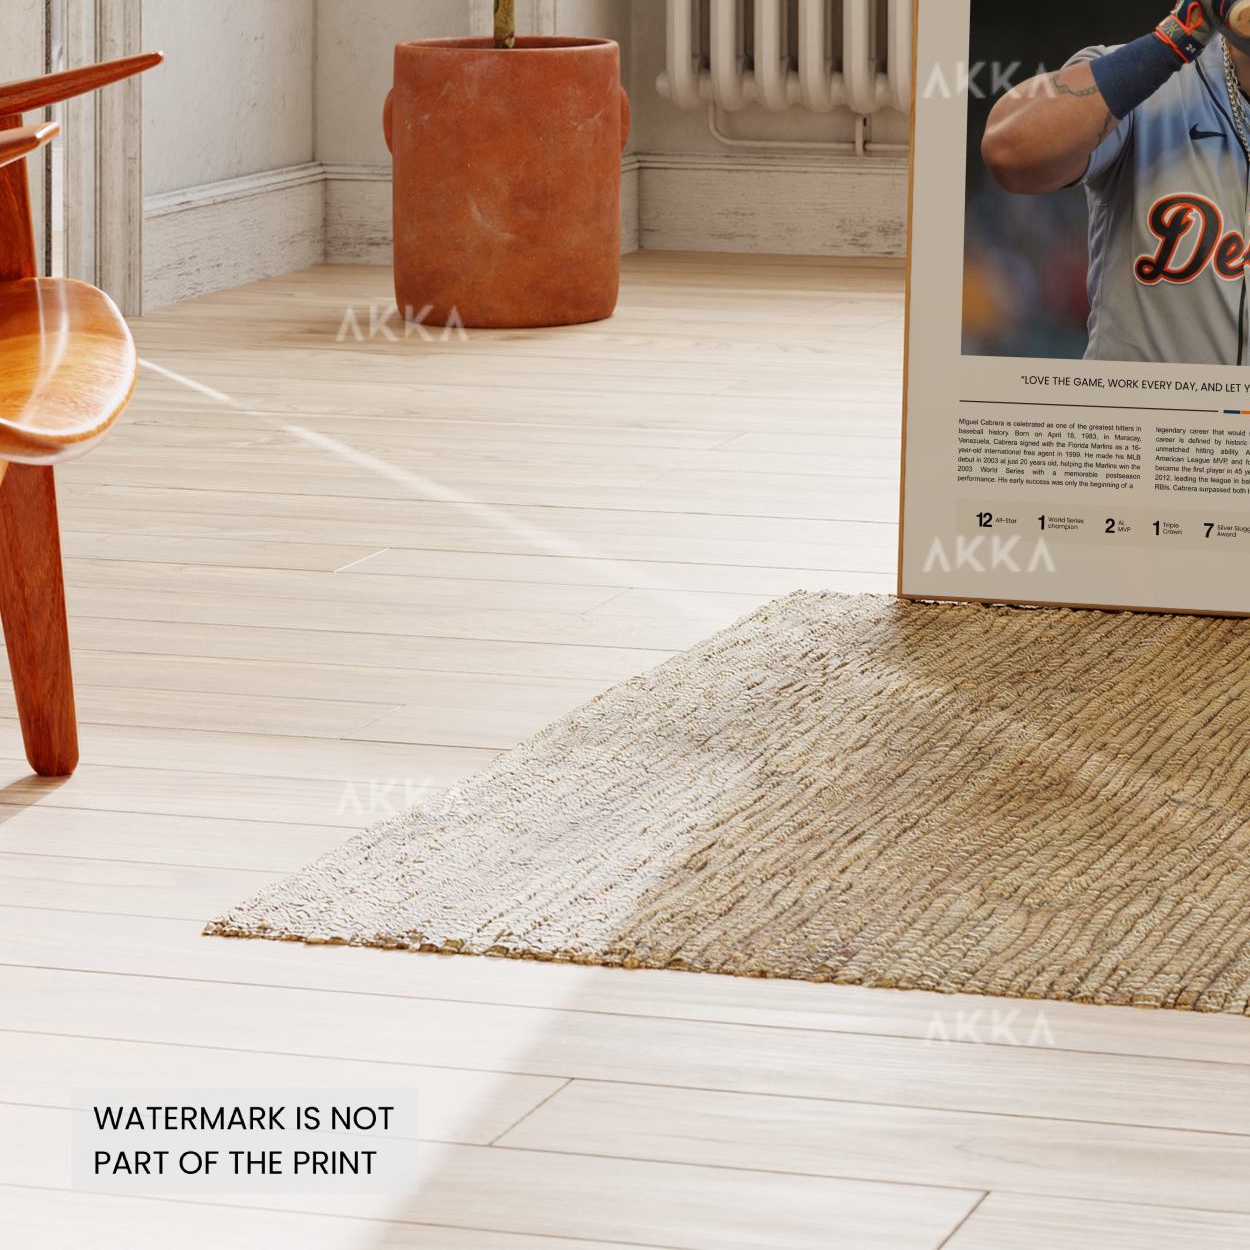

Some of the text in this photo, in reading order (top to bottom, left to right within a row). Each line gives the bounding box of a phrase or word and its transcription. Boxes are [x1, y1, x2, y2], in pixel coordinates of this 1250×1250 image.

[1185, 43, 1197, 55] 24
[1052, 376, 1070, 386] THE
[1073, 377, 1105, 389] GAME,
[1107, 378, 1139, 389] WORK
[1141, 379, 1172, 390] EVERY
[1174, 381, 1198, 393] DAY,
[1200, 382, 1223, 392] AND
[1225, 383, 1242, 393] LET
[976, 512, 993, 528] 12
[1038, 515, 1045, 530] 1
[1105, 518, 1115, 533] 2
[1153, 521, 1160, 535] 1
[1204, 523, 1214, 538] 7
